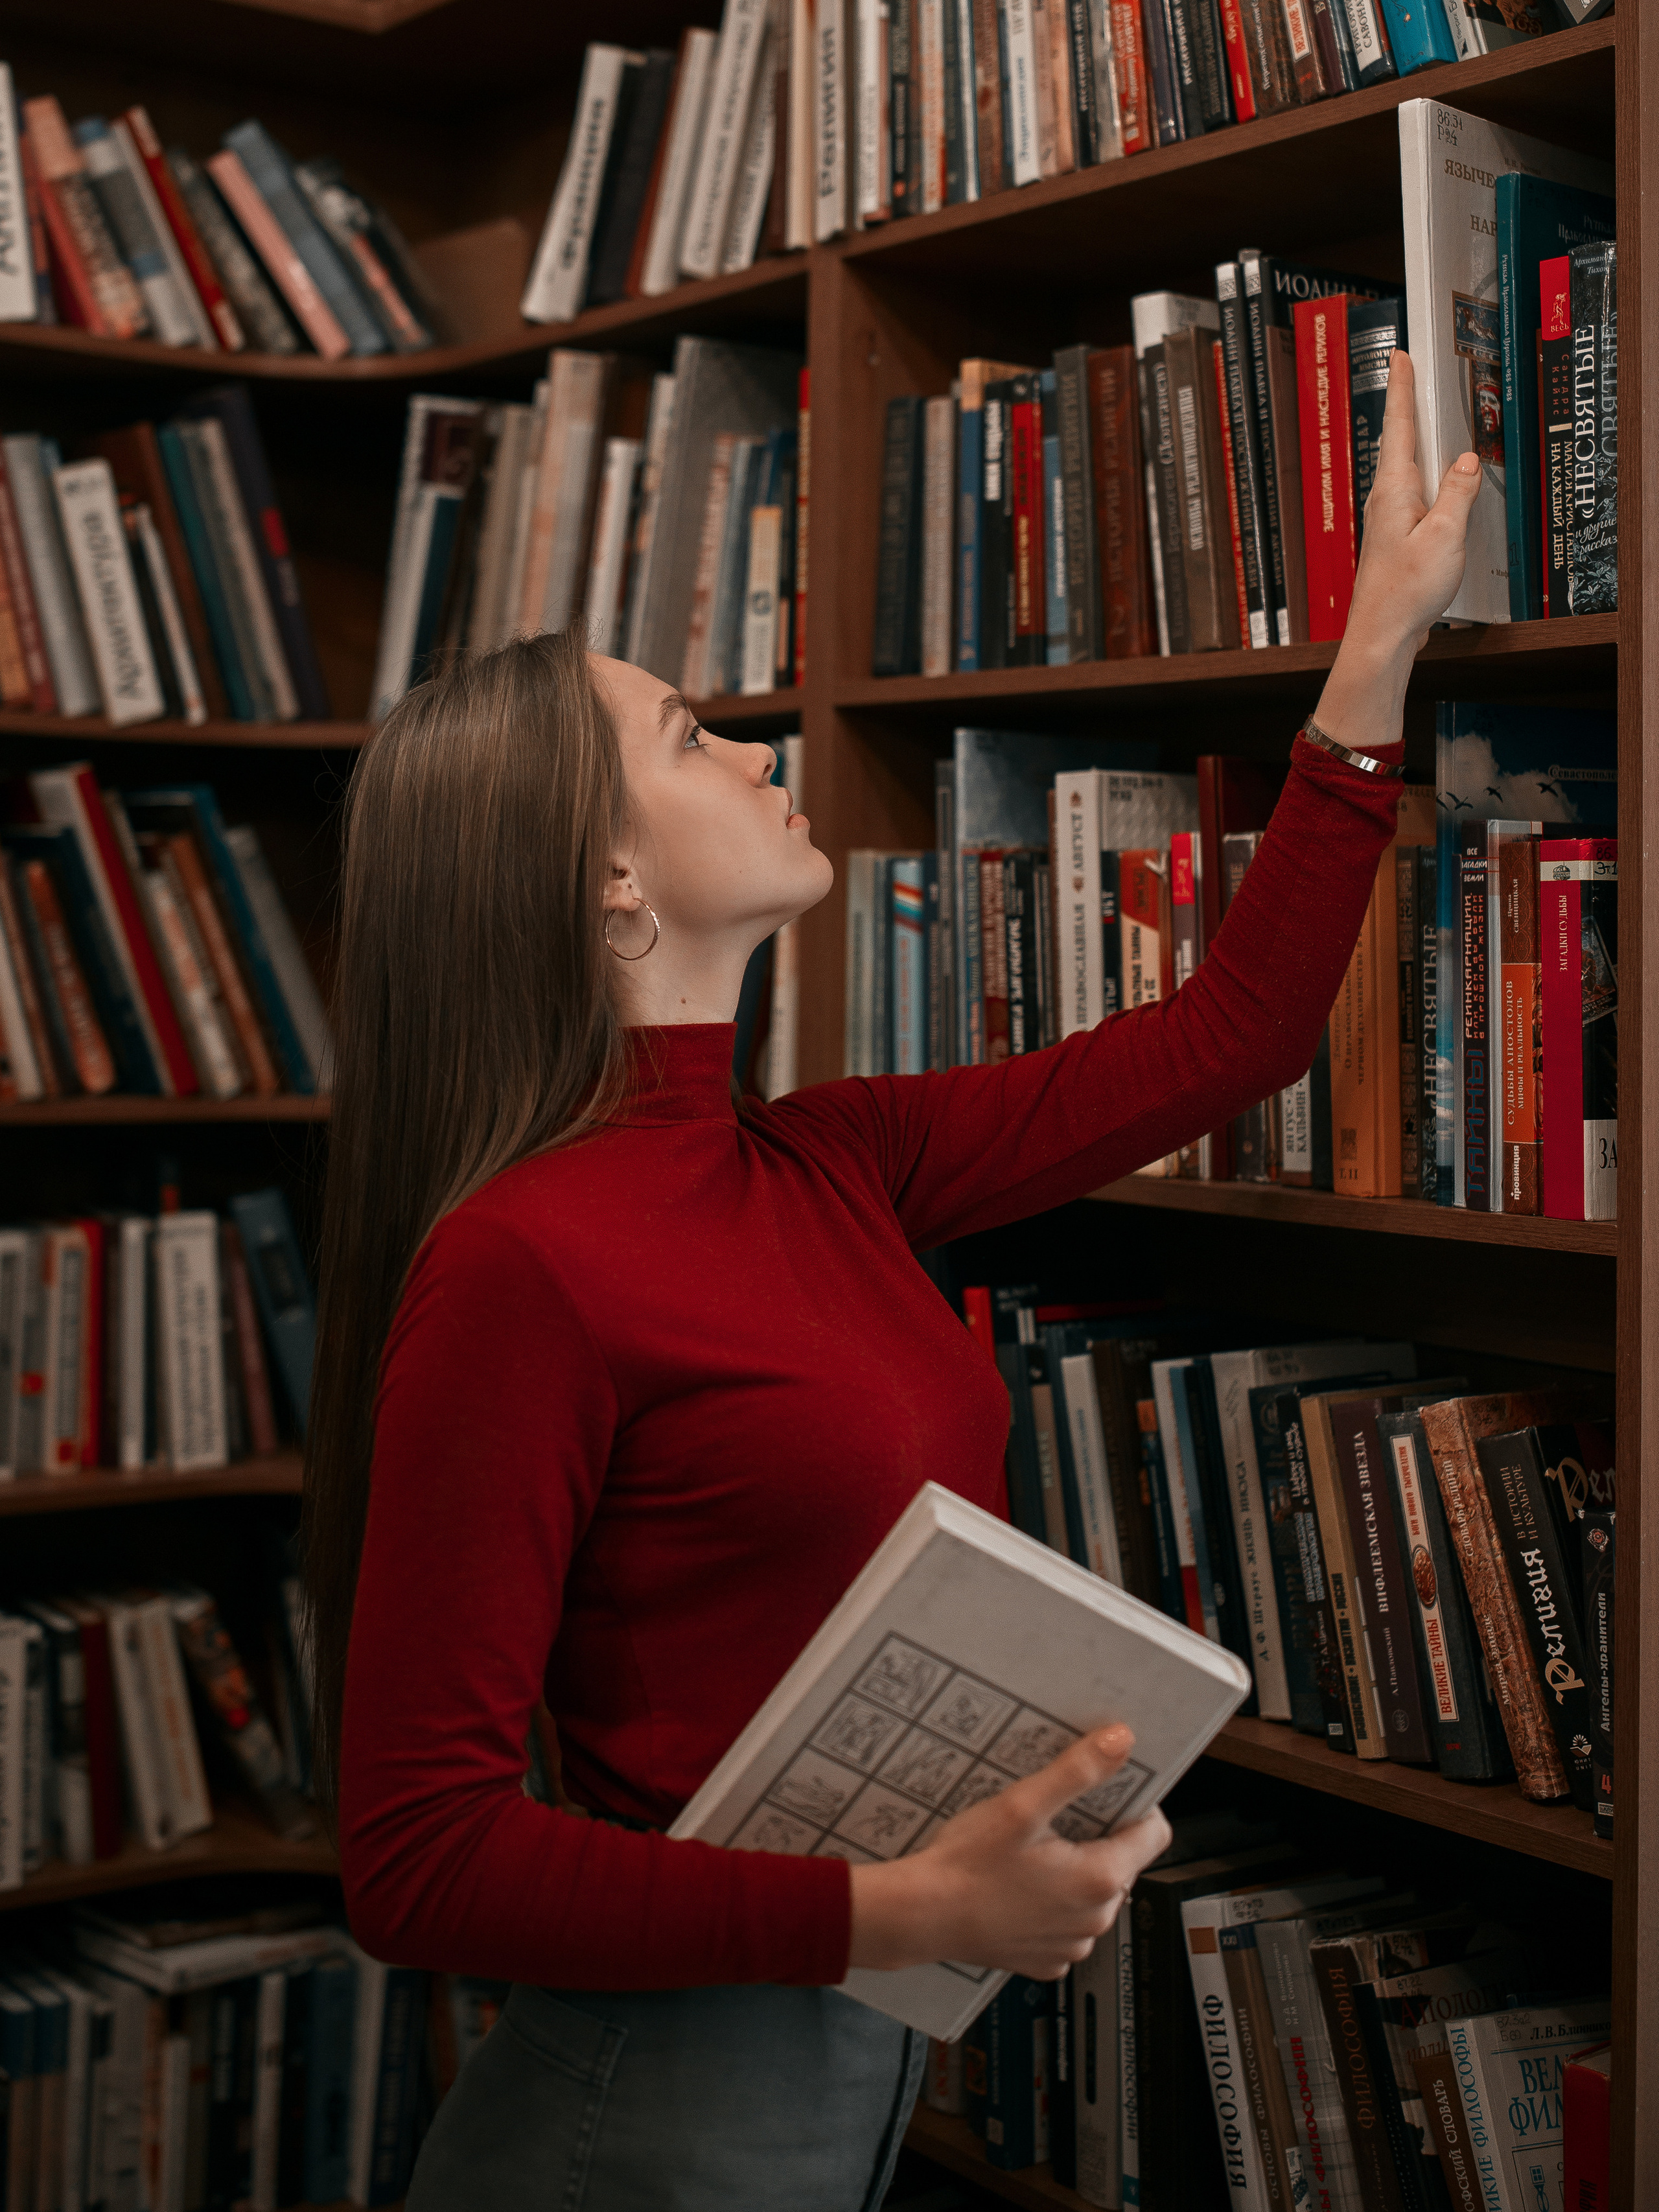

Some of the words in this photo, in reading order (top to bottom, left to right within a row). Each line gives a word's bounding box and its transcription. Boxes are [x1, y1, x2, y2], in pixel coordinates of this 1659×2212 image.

[1316, 365, 1331, 426] НАСЛЕДИЕ
[1551, 366, 1560, 415] Кайнс
[1574, 324, 1596, 518] «НЕСВЯТЫЕ
[1319, 442, 1331, 469] ИМЯ
[1550, 443, 1560, 462] НА
[1563, 441, 1573, 489] МАГИЯ
[1320, 472, 1334, 531] ЗАЩИТИМ
[1551, 466, 1564, 527] КАЖДЫЙ
[1509, 542, 1520, 567] 1
[1553, 534, 1564, 569] ДЕНЬ
[1463, 874, 1484, 883] ЗЕМЛИ
[1557, 894, 1568, 931] СУДЬБЫ
[1558, 932, 1570, 972] ЗАГАДКИ
[1505, 981, 1514, 1066] АПОСТОЛОВ
[1514, 996, 1525, 1064] РЕАЛЬНОСТЬ
[1506, 1069, 1516, 1125] СУДЬБЫ
[1516, 1076, 1525, 1109] МИФЫ
[1464, 1048, 1485, 1200] ТАЙНЫ
[1511, 1145, 1521, 1200] провинция
[1599, 1137, 1618, 1169] ЗА
[1351, 1430, 1371, 1488] ЗВЕЗДА
[1499, 1465, 1524, 1527] ИСТОРИИ
[1511, 1463, 1535, 1526] КУЛЬТУРЕ
[1360, 1491, 1389, 1613] ВИФЛЕЕМСКАЯ
[1410, 1519, 1421, 1535] БОГИ
[1454, 1509, 1476, 1557] СЛОВАРЬ
[1516, 1530, 1526, 1539] В
[1527, 1529, 1538, 1540] И
[1423, 1618, 1443, 1659] ТАЙНЫ
[1520, 1547, 1585, 1705] Религия
[1432, 1660, 1453, 1715] ВЕЛИКИЕ
[1492, 1662, 1513, 1705] Мирча
[1596, 1592, 1609, 1732] Ангелы-хранители
[1601, 1774, 1612, 1794] 4
[1236, 2007, 1266, 2121] ФИЛОСОФИИ
[1328, 1965, 1376, 2130] ФИЛОСОФИЯ
[1201, 1993, 1251, 2191] ФИЛОСОФИЯ
[1290, 2036, 1326, 2182] ФИЛОСОФИИ
[1432, 2078, 1458, 2144] СЛОВАРЬ
[1449, 2025, 1490, 2148] ФИЛОСОФЫ
[1259, 2127, 1280, 2200] ОСНОВЫ
[1448, 2147, 1476, 2212] ОФСКИЙ
